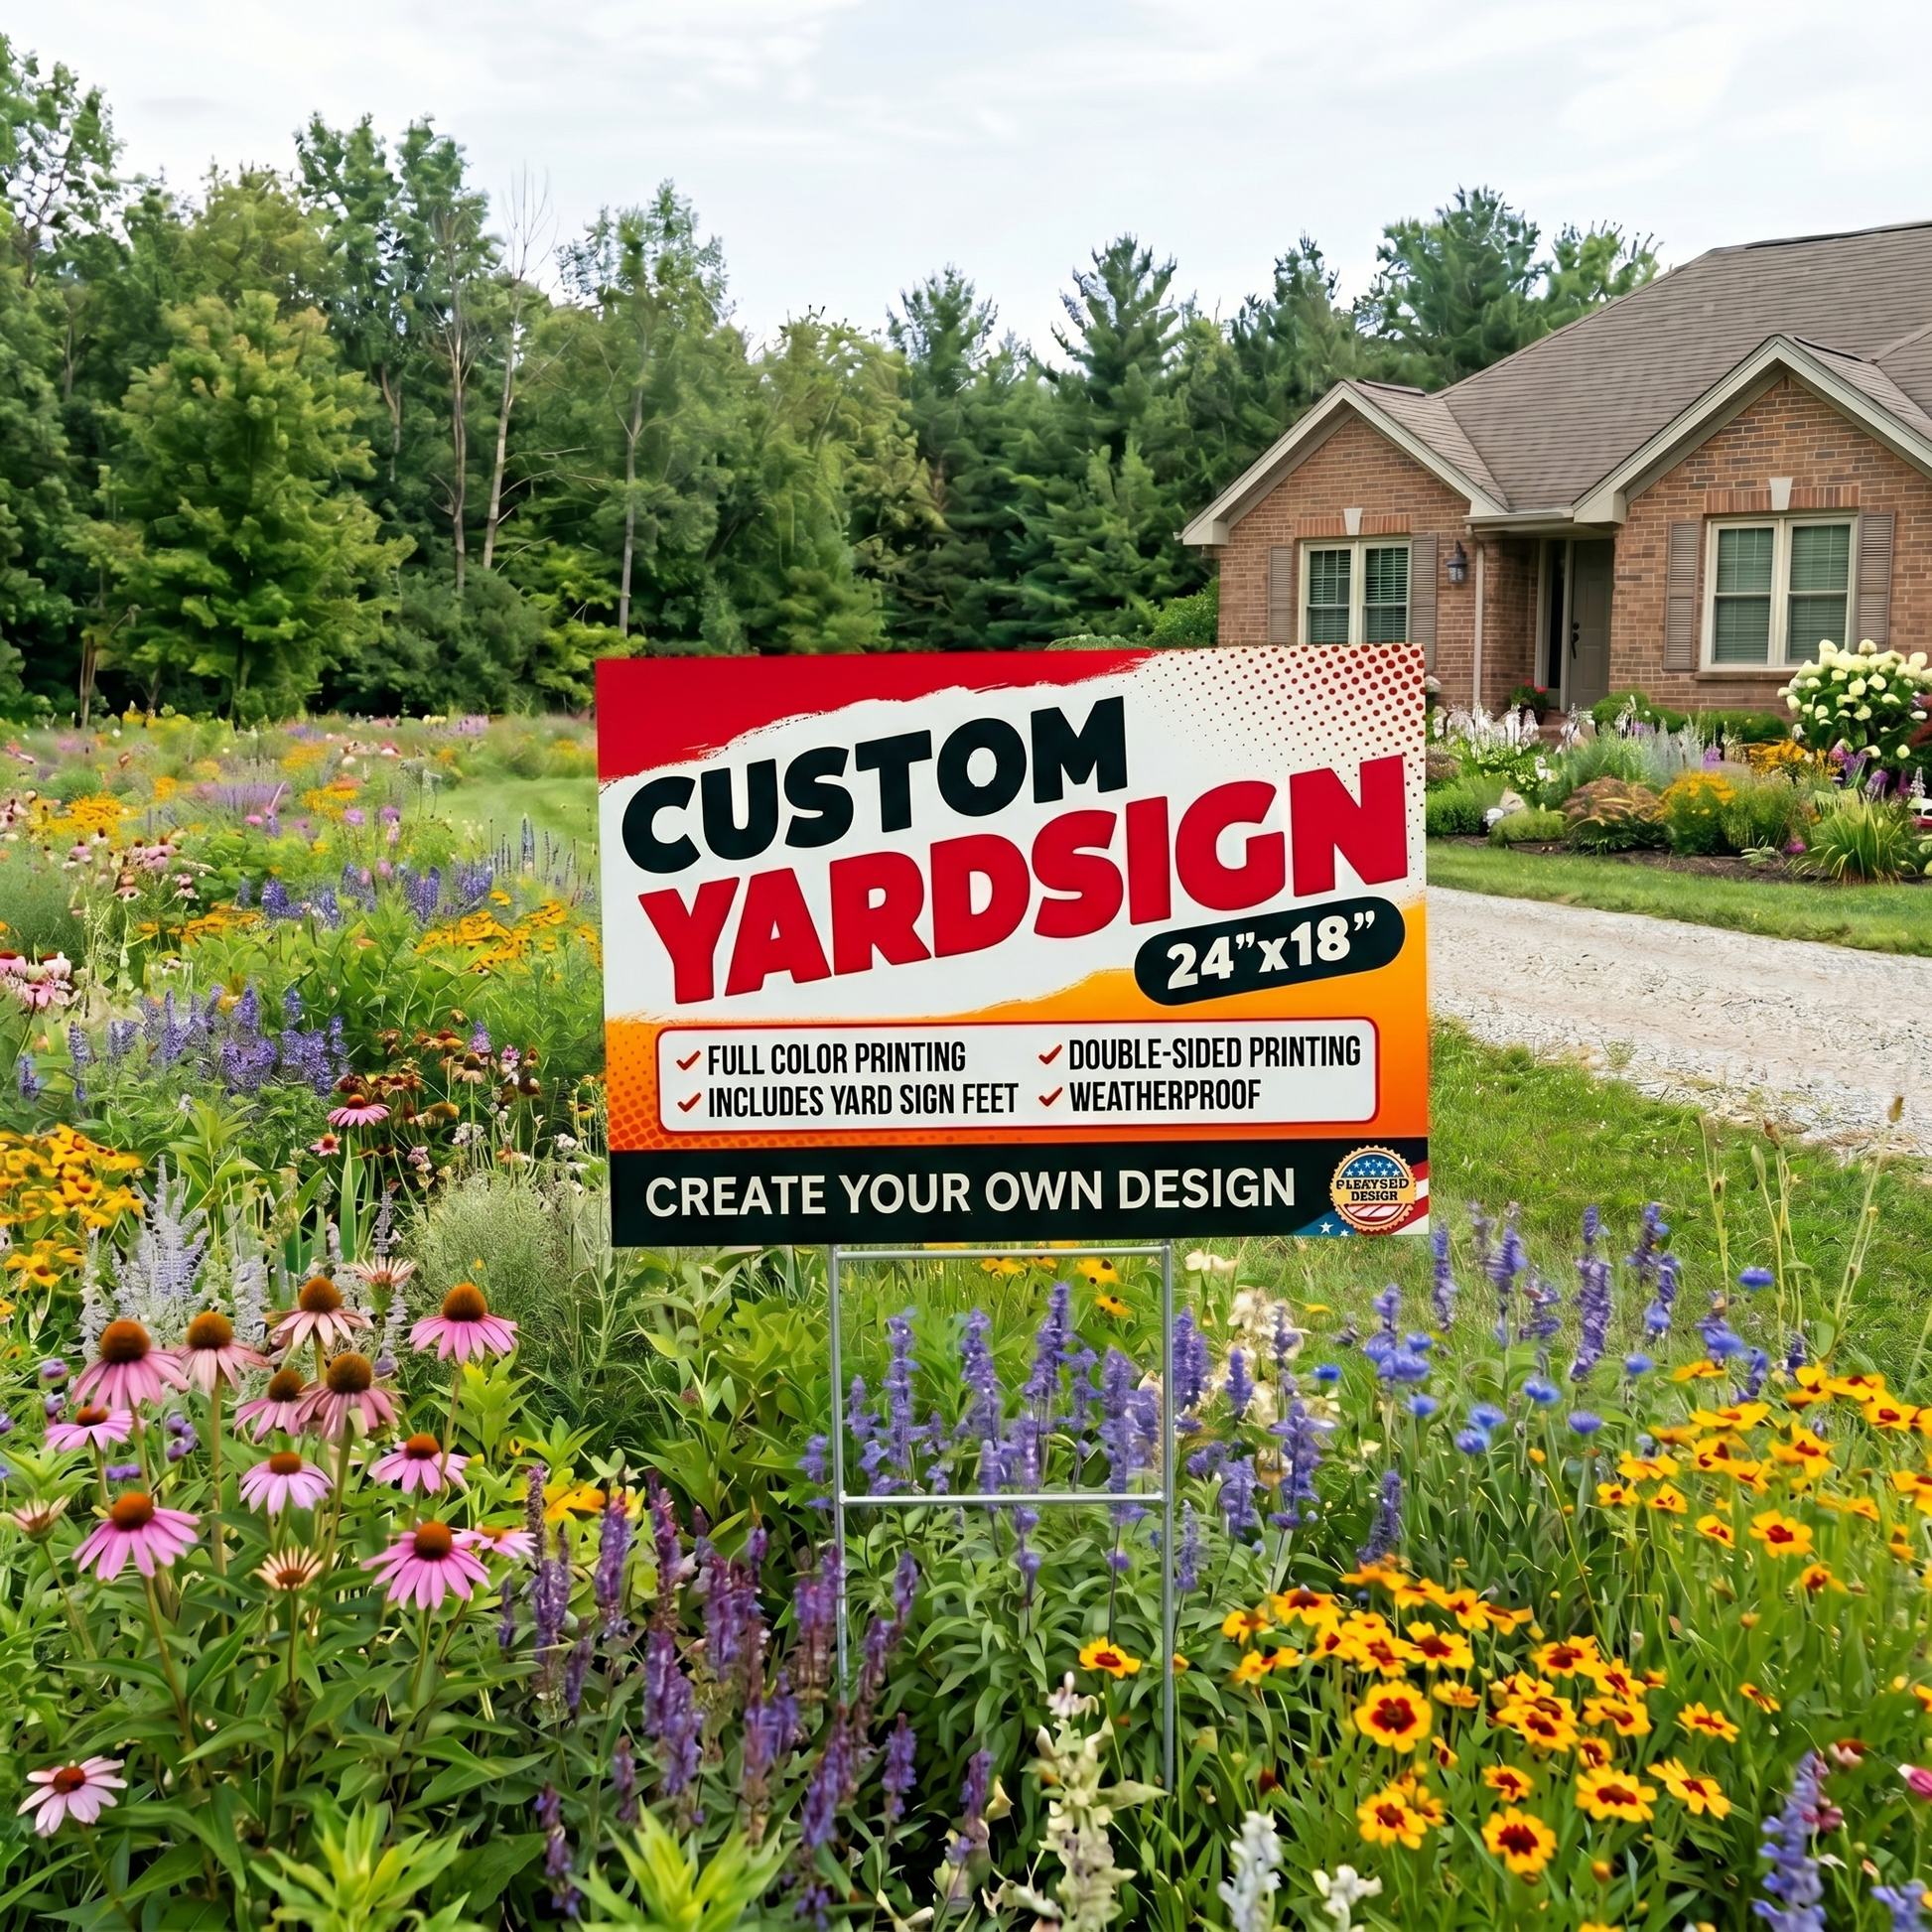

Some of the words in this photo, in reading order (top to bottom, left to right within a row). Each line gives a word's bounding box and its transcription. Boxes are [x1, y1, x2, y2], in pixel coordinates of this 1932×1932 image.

[621, 695, 1128, 875] CUSTOM
[638, 754, 1409, 1003] YARDSIGN
[708, 1044, 765, 1076] FULL
[770, 1042, 848, 1075] COLOR
[855, 1040, 966, 1073] PRINTING
[1069, 1036, 1242, 1070] DOUBLE-SIDED
[1249, 1035, 1361, 1068] PRINTING
[709, 1085, 825, 1118] INCLUDES
[830, 1084, 893, 1116] YARD
[899, 1083, 955, 1115] SIGN
[962, 1082, 1020, 1114] FEET
[1069, 1078, 1262, 1112] WEATHERPROOF
[645, 1174, 826, 1217] CREATE
[838, 1173, 971, 1214] YOUR
[985, 1171, 1103, 1212] OWN
[1119, 1168, 1295, 1209] DESIGN
